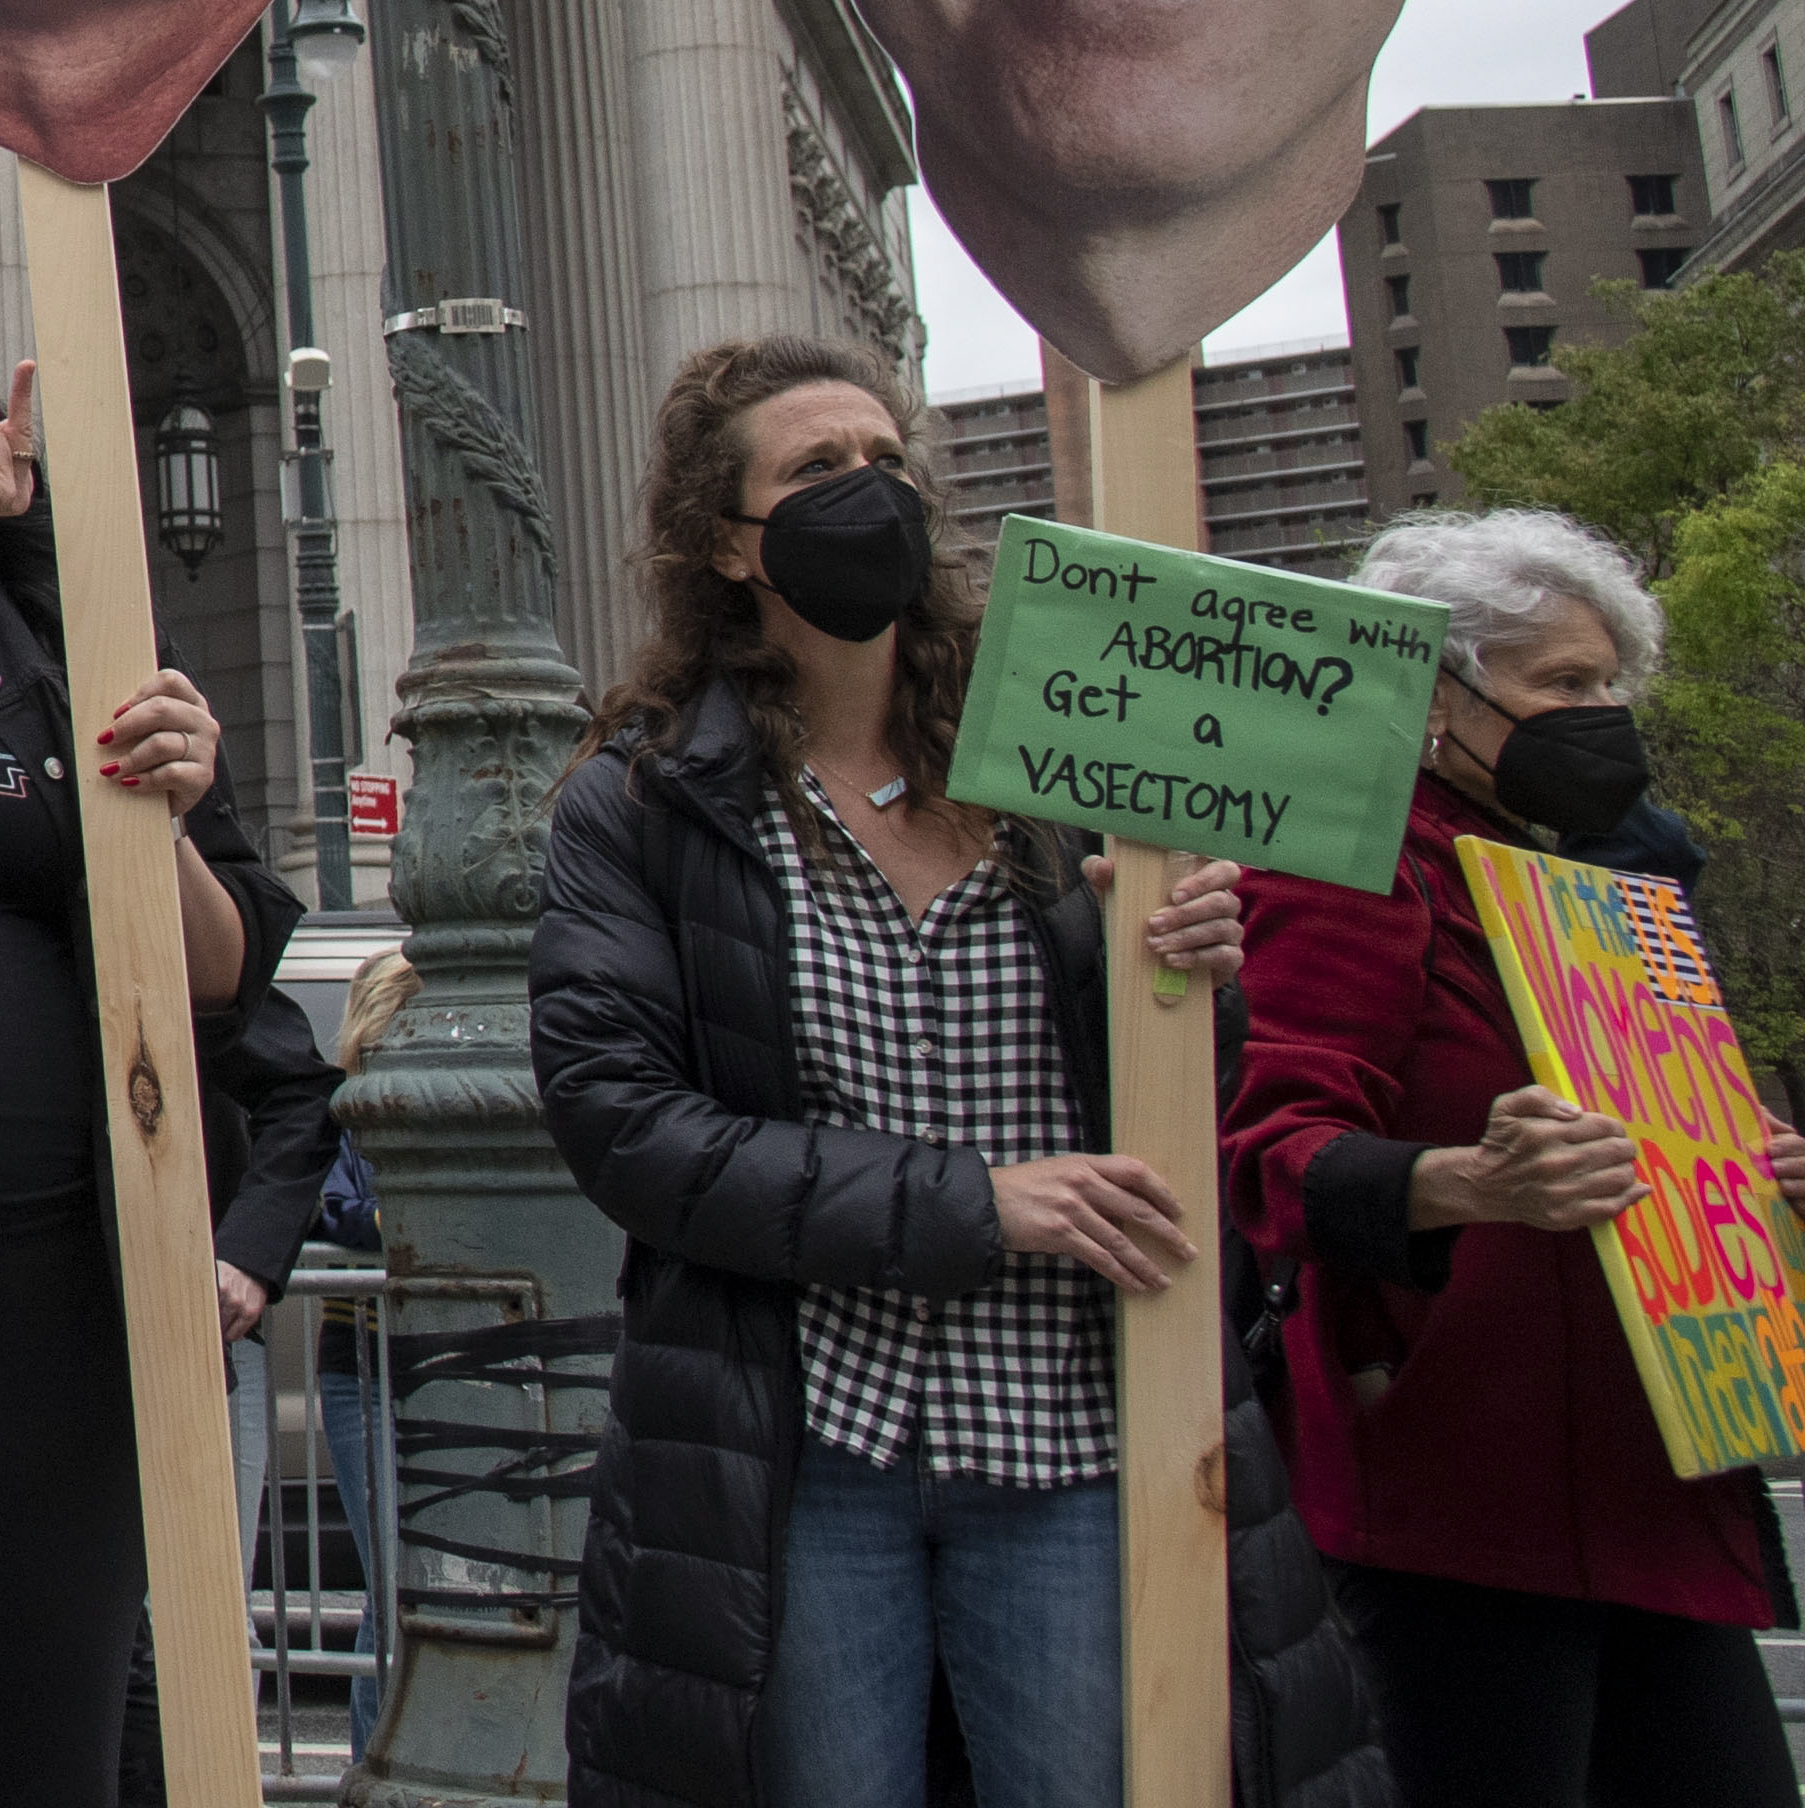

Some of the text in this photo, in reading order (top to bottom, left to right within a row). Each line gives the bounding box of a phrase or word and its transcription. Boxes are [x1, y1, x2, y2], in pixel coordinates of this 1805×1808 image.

[1023, 538, 1431, 664] Don't agree with
[1042, 669, 1224, 748] Get a
[1099, 621, 1354, 716] ABORTION?
